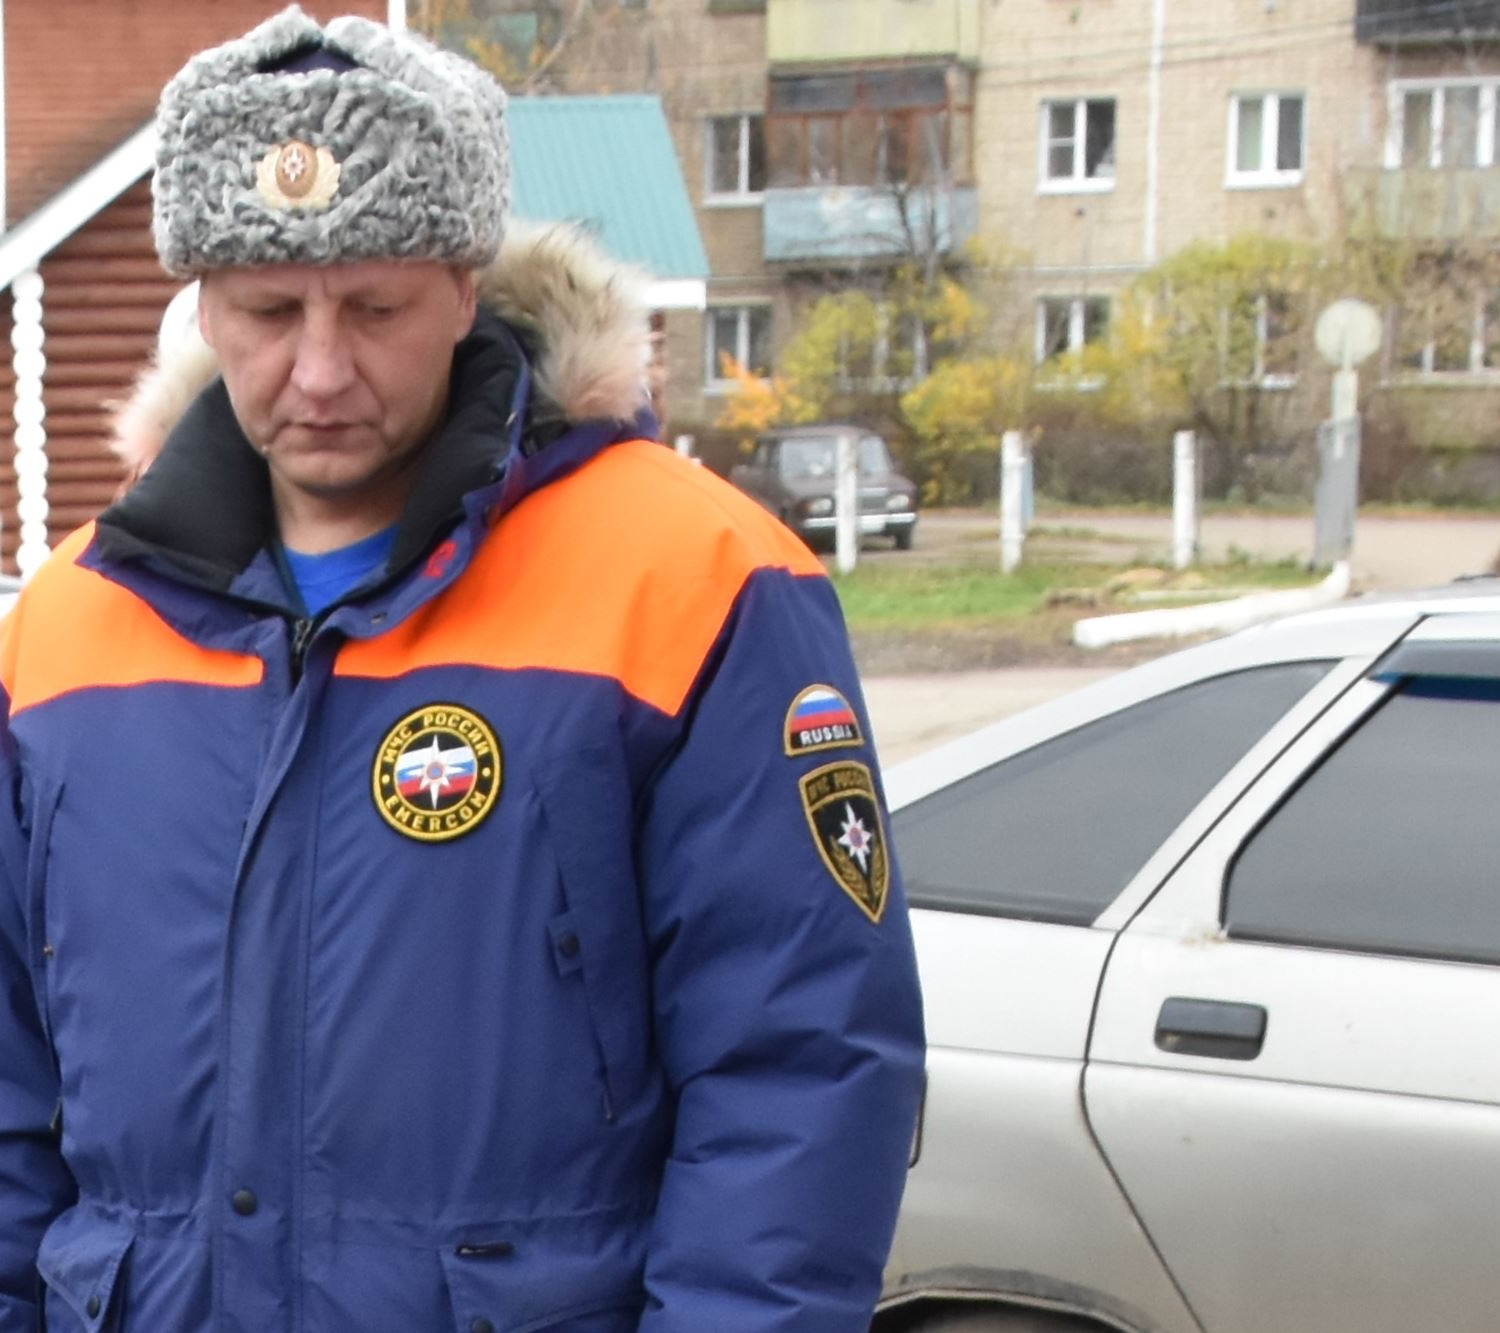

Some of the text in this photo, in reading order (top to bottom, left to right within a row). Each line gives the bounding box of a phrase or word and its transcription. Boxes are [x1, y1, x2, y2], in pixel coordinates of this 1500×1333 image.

[383, 712, 490, 763] МЧС РОССИИ
[800, 723, 854, 745] RUSSIA
[385, 791, 487, 832] EMERCOM
